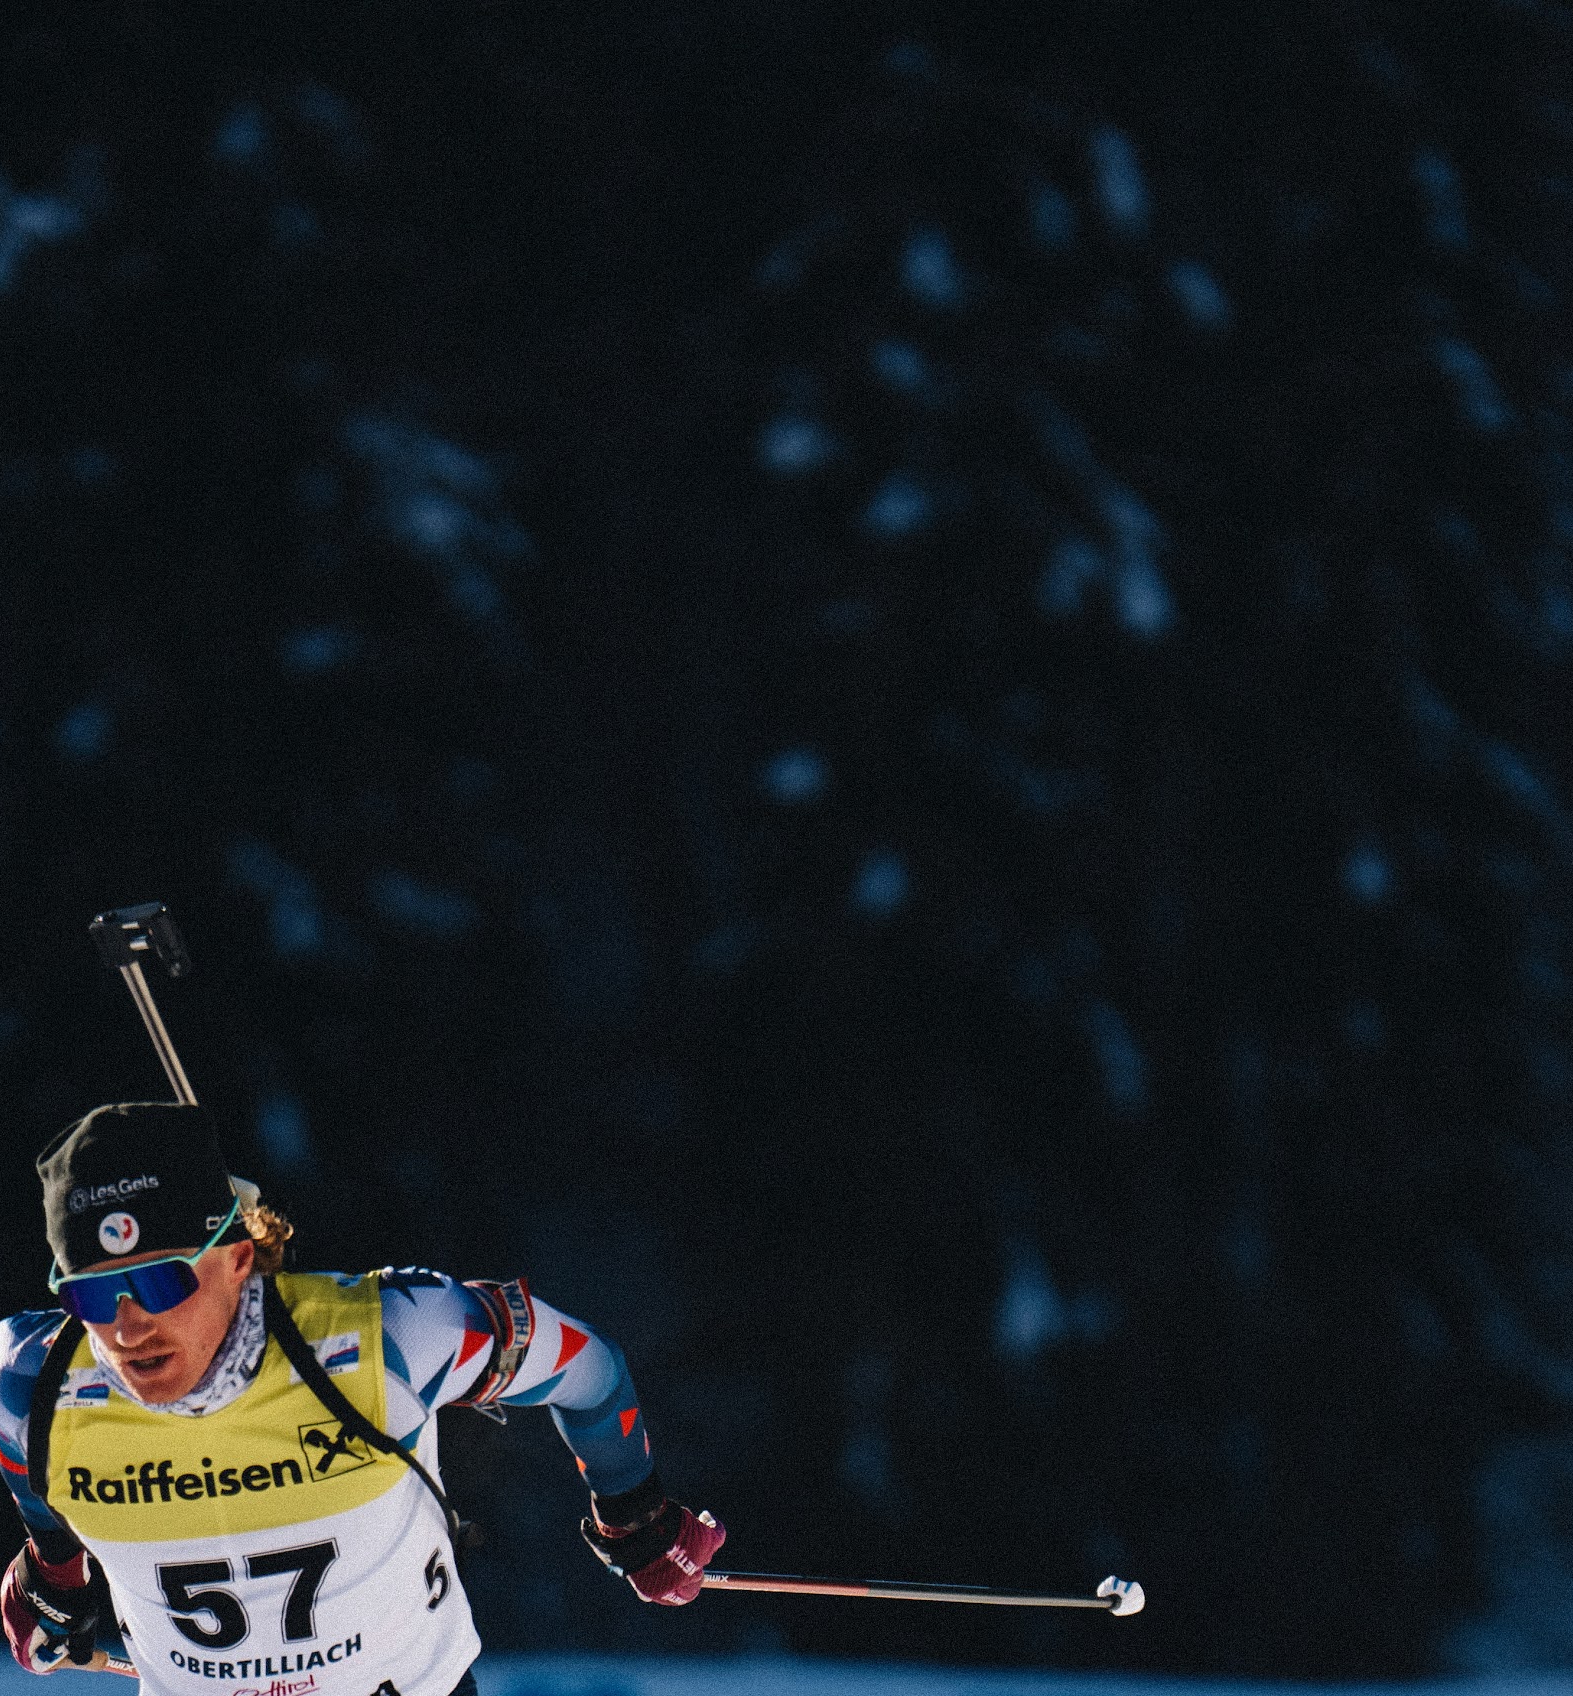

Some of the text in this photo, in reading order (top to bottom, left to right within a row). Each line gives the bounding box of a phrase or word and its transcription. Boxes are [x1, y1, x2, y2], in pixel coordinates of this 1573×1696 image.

[90, 1185, 117, 1201] Les
[118, 1174, 159, 1195] Gets
[68, 1457, 303, 1504] Raiffeisen
[28, 1591, 71, 1623] SWIX
[155, 1537, 340, 1652] 57
[170, 1633, 363, 1679] OBERTILLIACH
